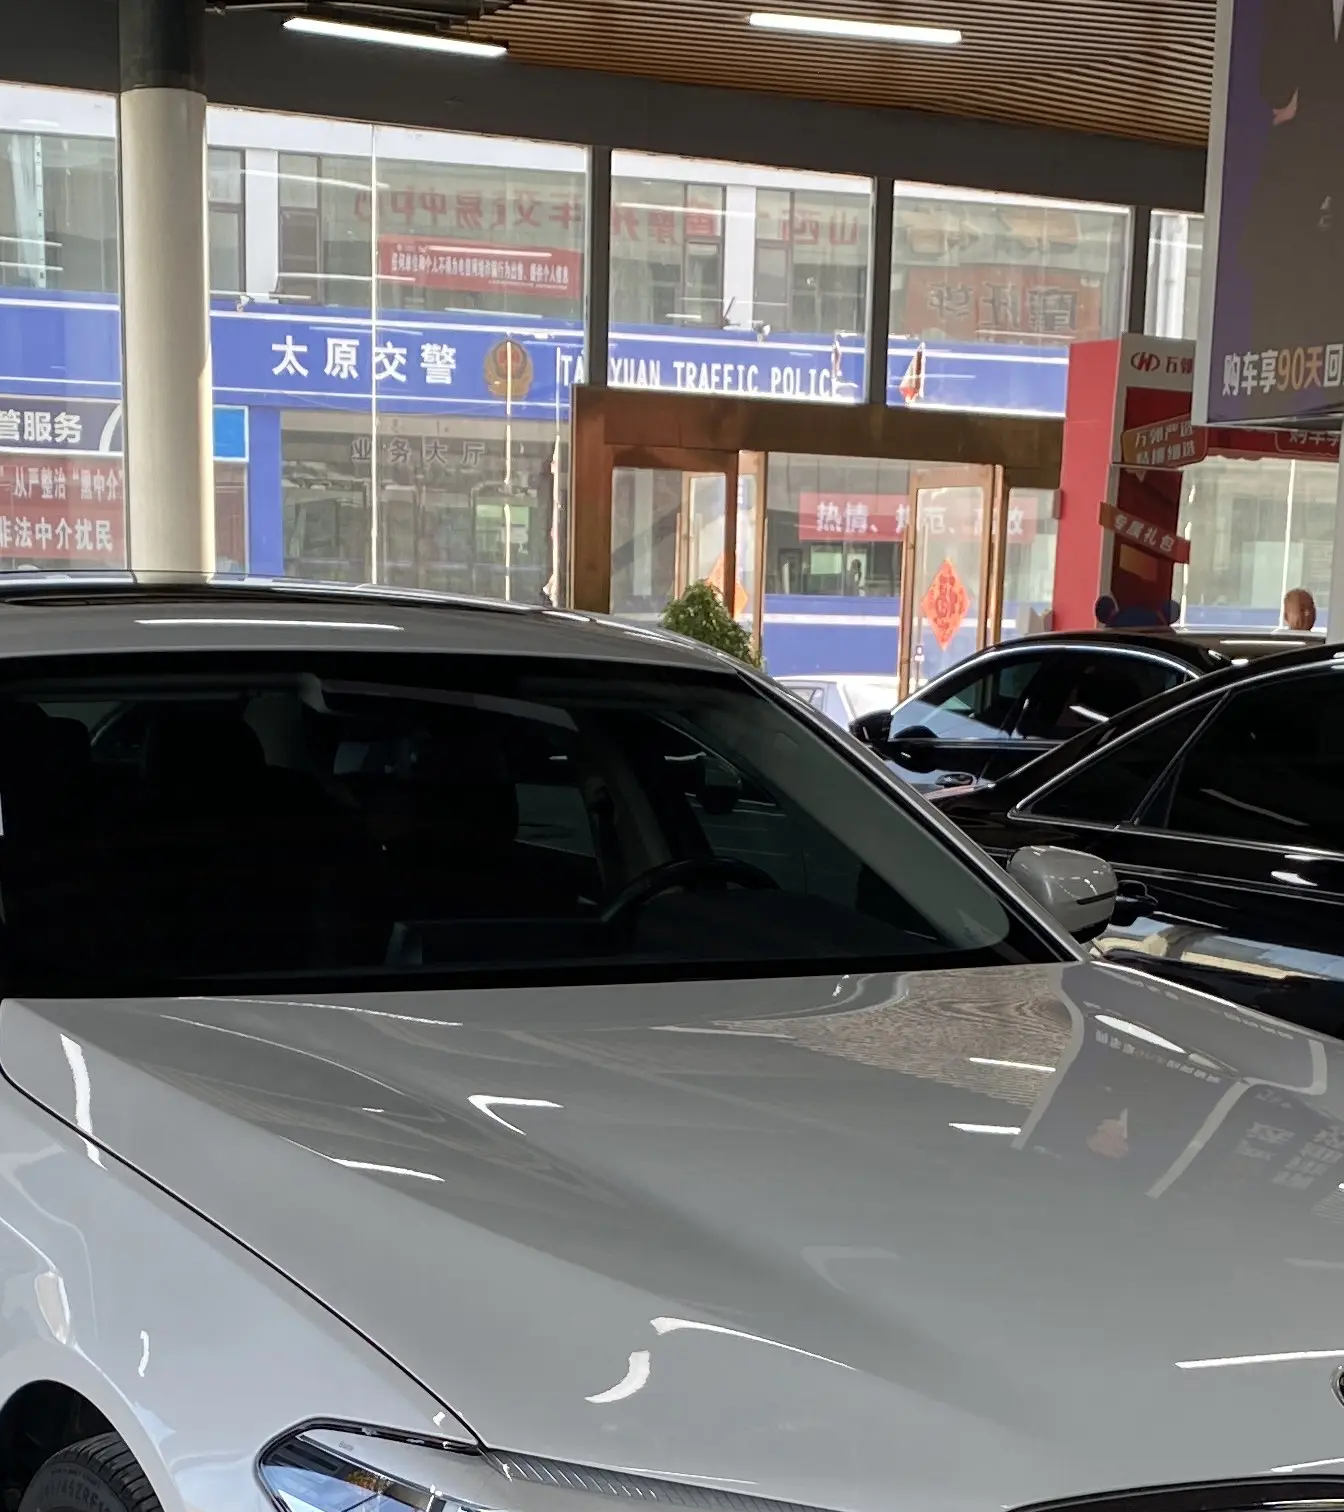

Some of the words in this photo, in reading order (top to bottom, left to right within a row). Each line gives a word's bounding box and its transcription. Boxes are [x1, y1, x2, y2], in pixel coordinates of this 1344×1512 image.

[272, 335, 457, 384] 太原交警
[561, 354, 660, 388] TAYUAN
[673, 361, 759, 394] TRAFFIC
[351, 437, 485, 465] 业务大厅
[1113, 513, 1177, 551] 专属礼包
